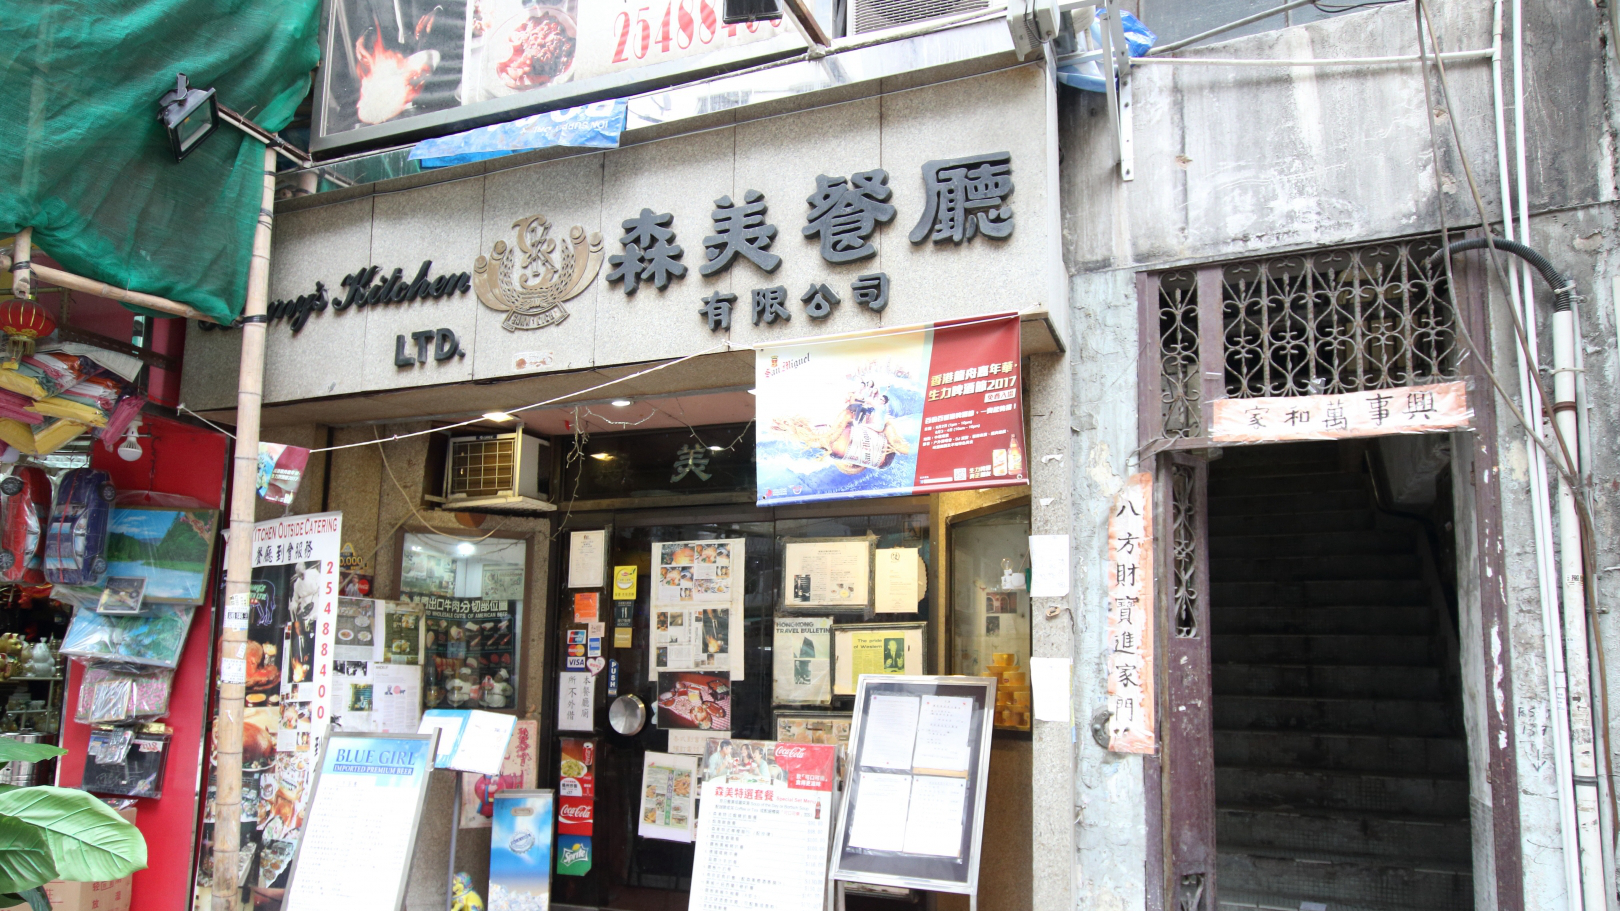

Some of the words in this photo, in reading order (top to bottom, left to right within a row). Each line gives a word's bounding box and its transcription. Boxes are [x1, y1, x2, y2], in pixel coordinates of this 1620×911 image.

[612, 0, 783, 64] 25488
[606, 151, 1015, 296] 森美餐廳
[332, 259, 472, 311] Kitchen
[698, 271, 891, 332] 有限公司
[394, 328, 466, 368] LTD.
[1245, 390, 1438, 432] 家和萬事興
[1114, 500, 1142, 722] 八方財寶進家門
[317, 561, 334, 719] 25488400
[609, 661, 617, 688] PUSH
[334, 764, 367, 773] IMPORTED
[366, 765, 396, 774] PREMIUM
[397, 766, 413, 775] BEER
[336, 748, 376, 763] BLUE
[378, 750, 415, 766] GIRL
[560, 803, 592, 818] Coca-Cola
